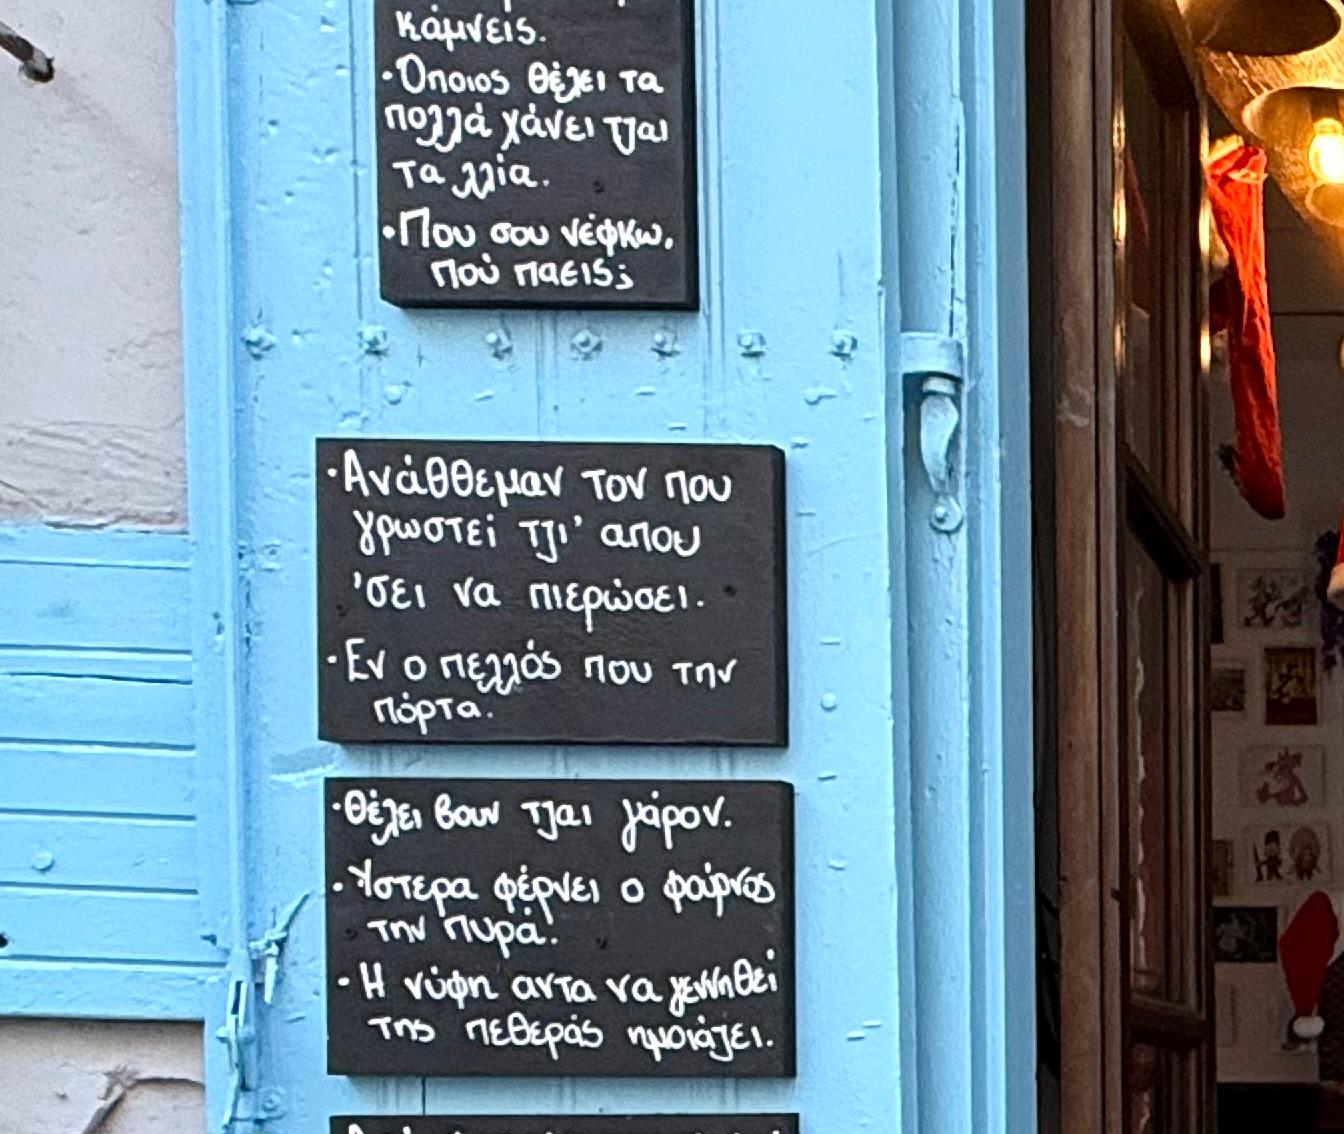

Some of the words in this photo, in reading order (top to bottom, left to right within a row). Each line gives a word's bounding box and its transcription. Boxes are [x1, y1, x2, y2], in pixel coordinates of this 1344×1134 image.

[529, 61, 605, 103] θέλει
[619, 70, 664, 93] τα
[385, 103, 492, 152] πολλά
[501, 103, 594, 150] χάνει
[603, 117, 667, 155] τζαι
[393, 161, 445, 188] τα
[400, 207, 475, 248] Που
[491, 223, 549, 247] σου
[431, 253, 499, 288] πού
[345, 449, 563, 507] Ανάθθεμαν
[581, 467, 647, 501] τον
[665, 471, 731, 504] που
[454, 577, 501, 607] να
[530, 579, 703, 632] πιερώσει.
[346, 638, 385, 681] Εν
[404, 656, 426, 680] ο
[441, 640, 561, 695] πελλός
[585, 655, 652, 684] που
[673, 659, 737, 688] την
[374, 692, 492, 735] πόρτα.
[435, 794, 499, 829] βουν
[521, 801, 591, 840] τζαι
[494, 865, 599, 925] φέρνει
[621, 878, 644, 902] ο
[664, 862, 775, 917] φούρνος
[367, 916, 425, 942] την
[444, 905, 557, 958] πυρά.
[360, 962, 385, 999] Η
[405, 966, 499, 1009] νύφη
[606, 975, 663, 1002] να
[669, 949, 777, 1017] γεννηθεί
[368, 1017, 435, 1042] της
[466, 1012, 603, 1059] πεθεράς
[628, 1015, 773, 1061] ημοιάζει.
